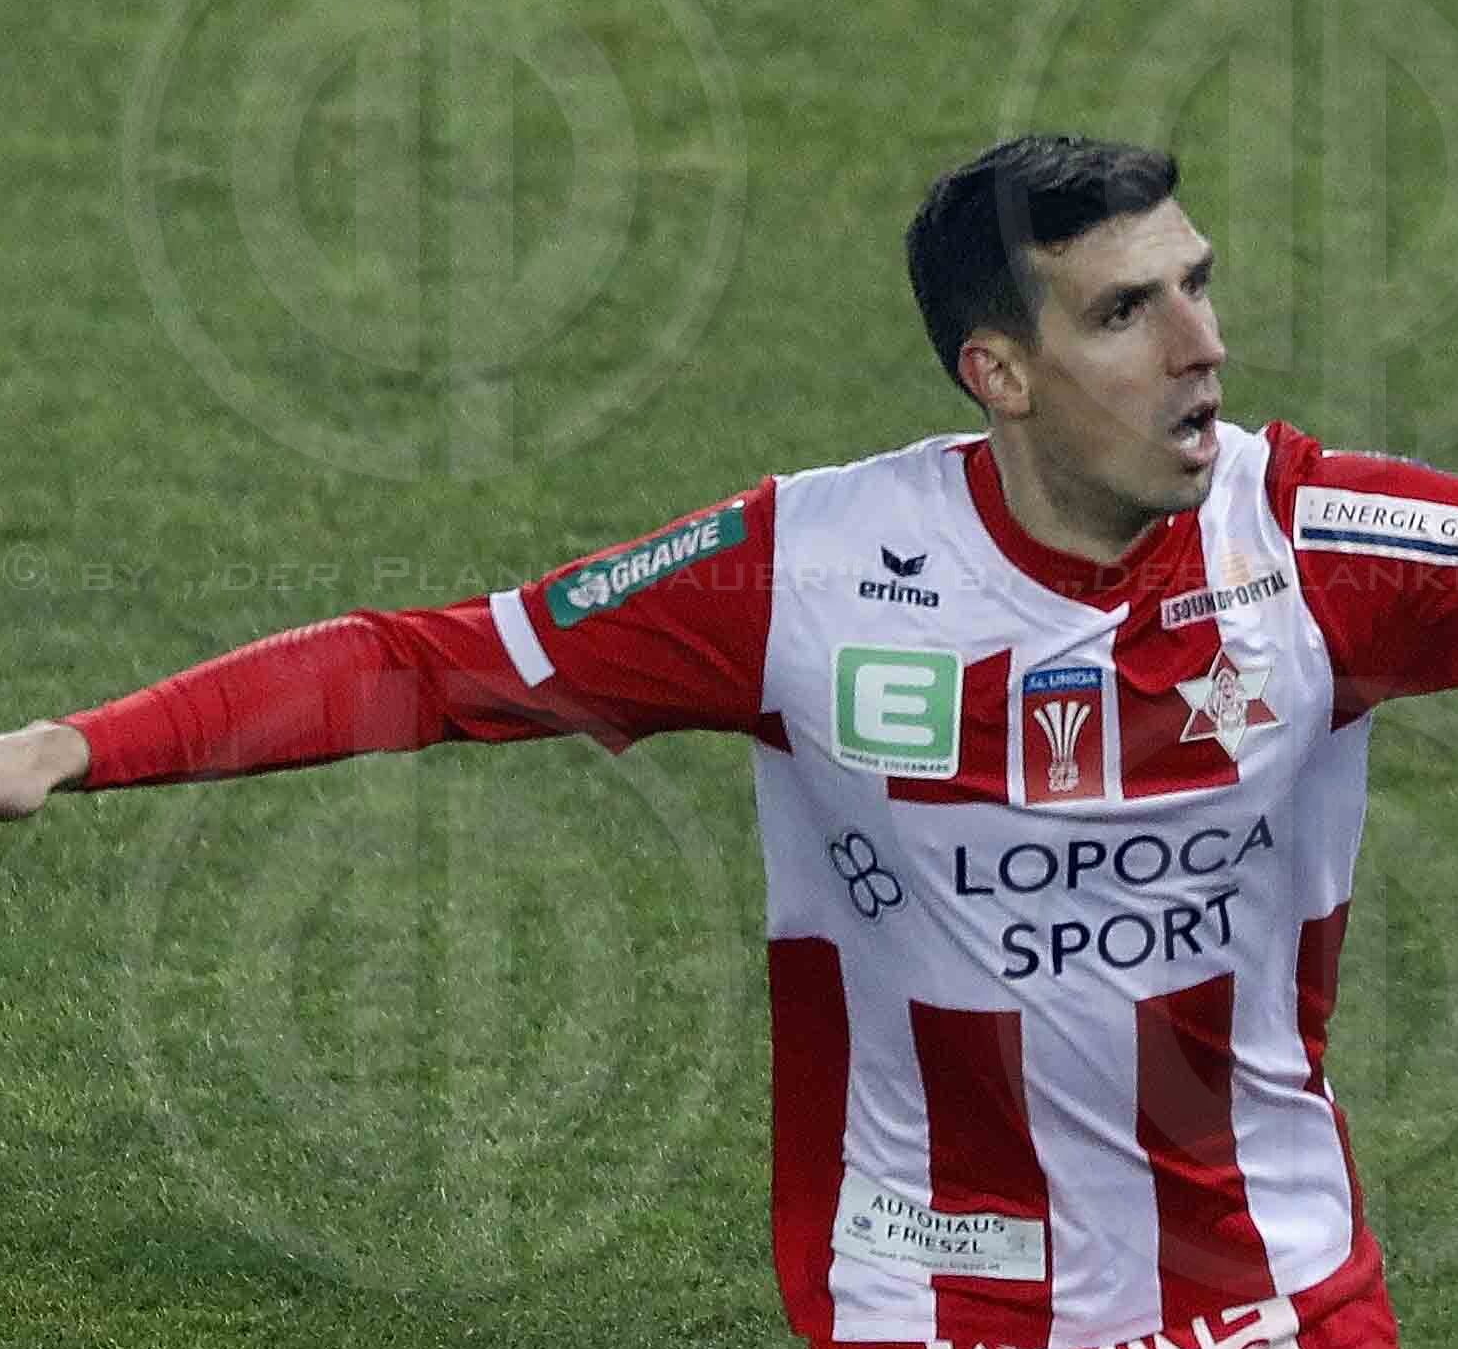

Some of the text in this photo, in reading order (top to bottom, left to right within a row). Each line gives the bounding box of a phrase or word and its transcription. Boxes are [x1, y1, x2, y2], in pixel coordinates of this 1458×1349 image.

[1322, 501, 1429, 534] ENERGIE
[610, 511, 720, 595] GRAWE
[858, 579, 941, 608] erima
[954, 814, 1275, 897] LOPOCA
[1001, 888, 1240, 981] SPORT
[870, 1193, 1006, 1235] AUTOHAUS
[887, 1222, 982, 1255] FRIESZL
